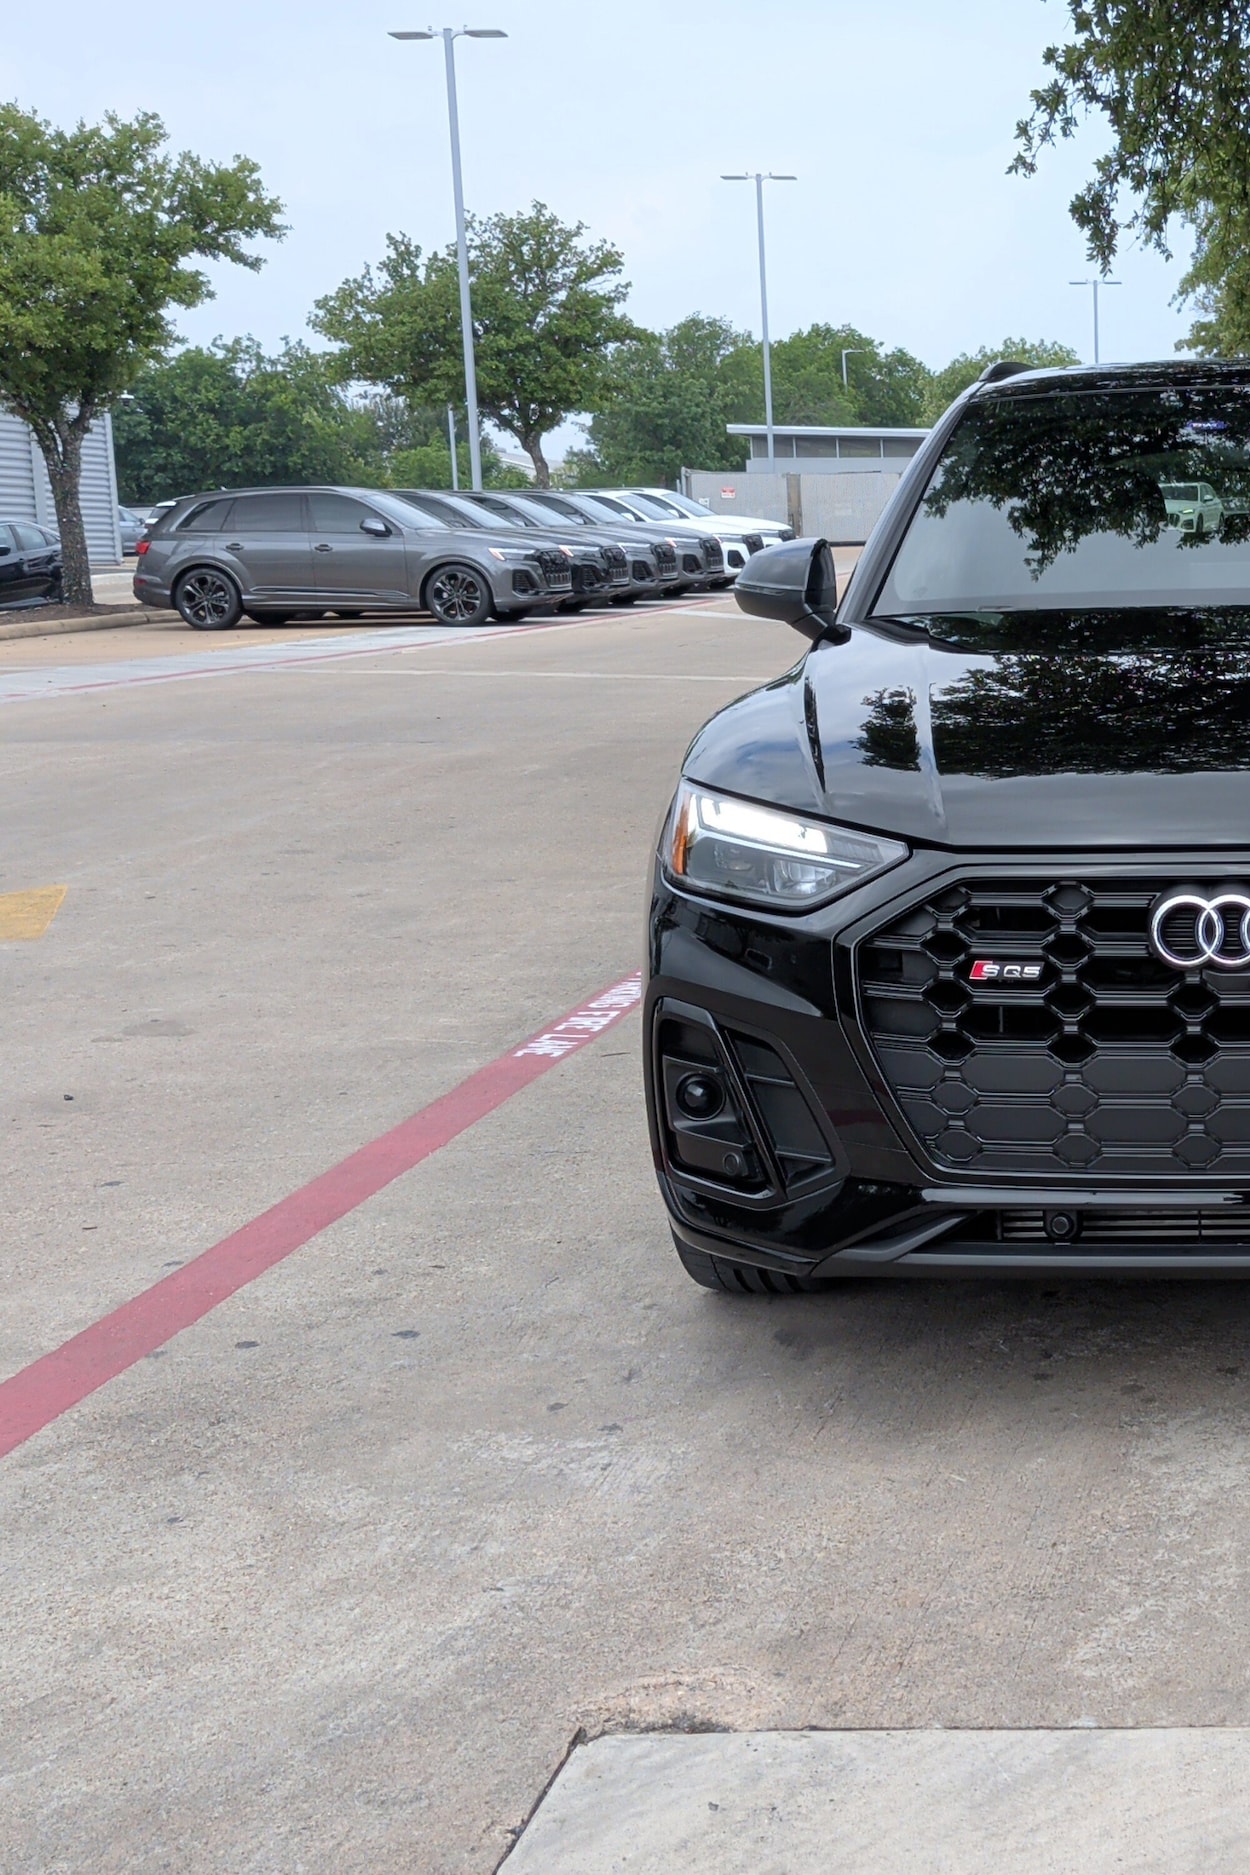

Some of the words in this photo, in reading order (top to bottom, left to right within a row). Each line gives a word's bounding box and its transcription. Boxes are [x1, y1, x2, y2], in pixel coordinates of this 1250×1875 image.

[977, 963, 1041, 979] SQ5
[553, 1011, 621, 1031] FIRE
[512, 1034, 590, 1057] LANE
